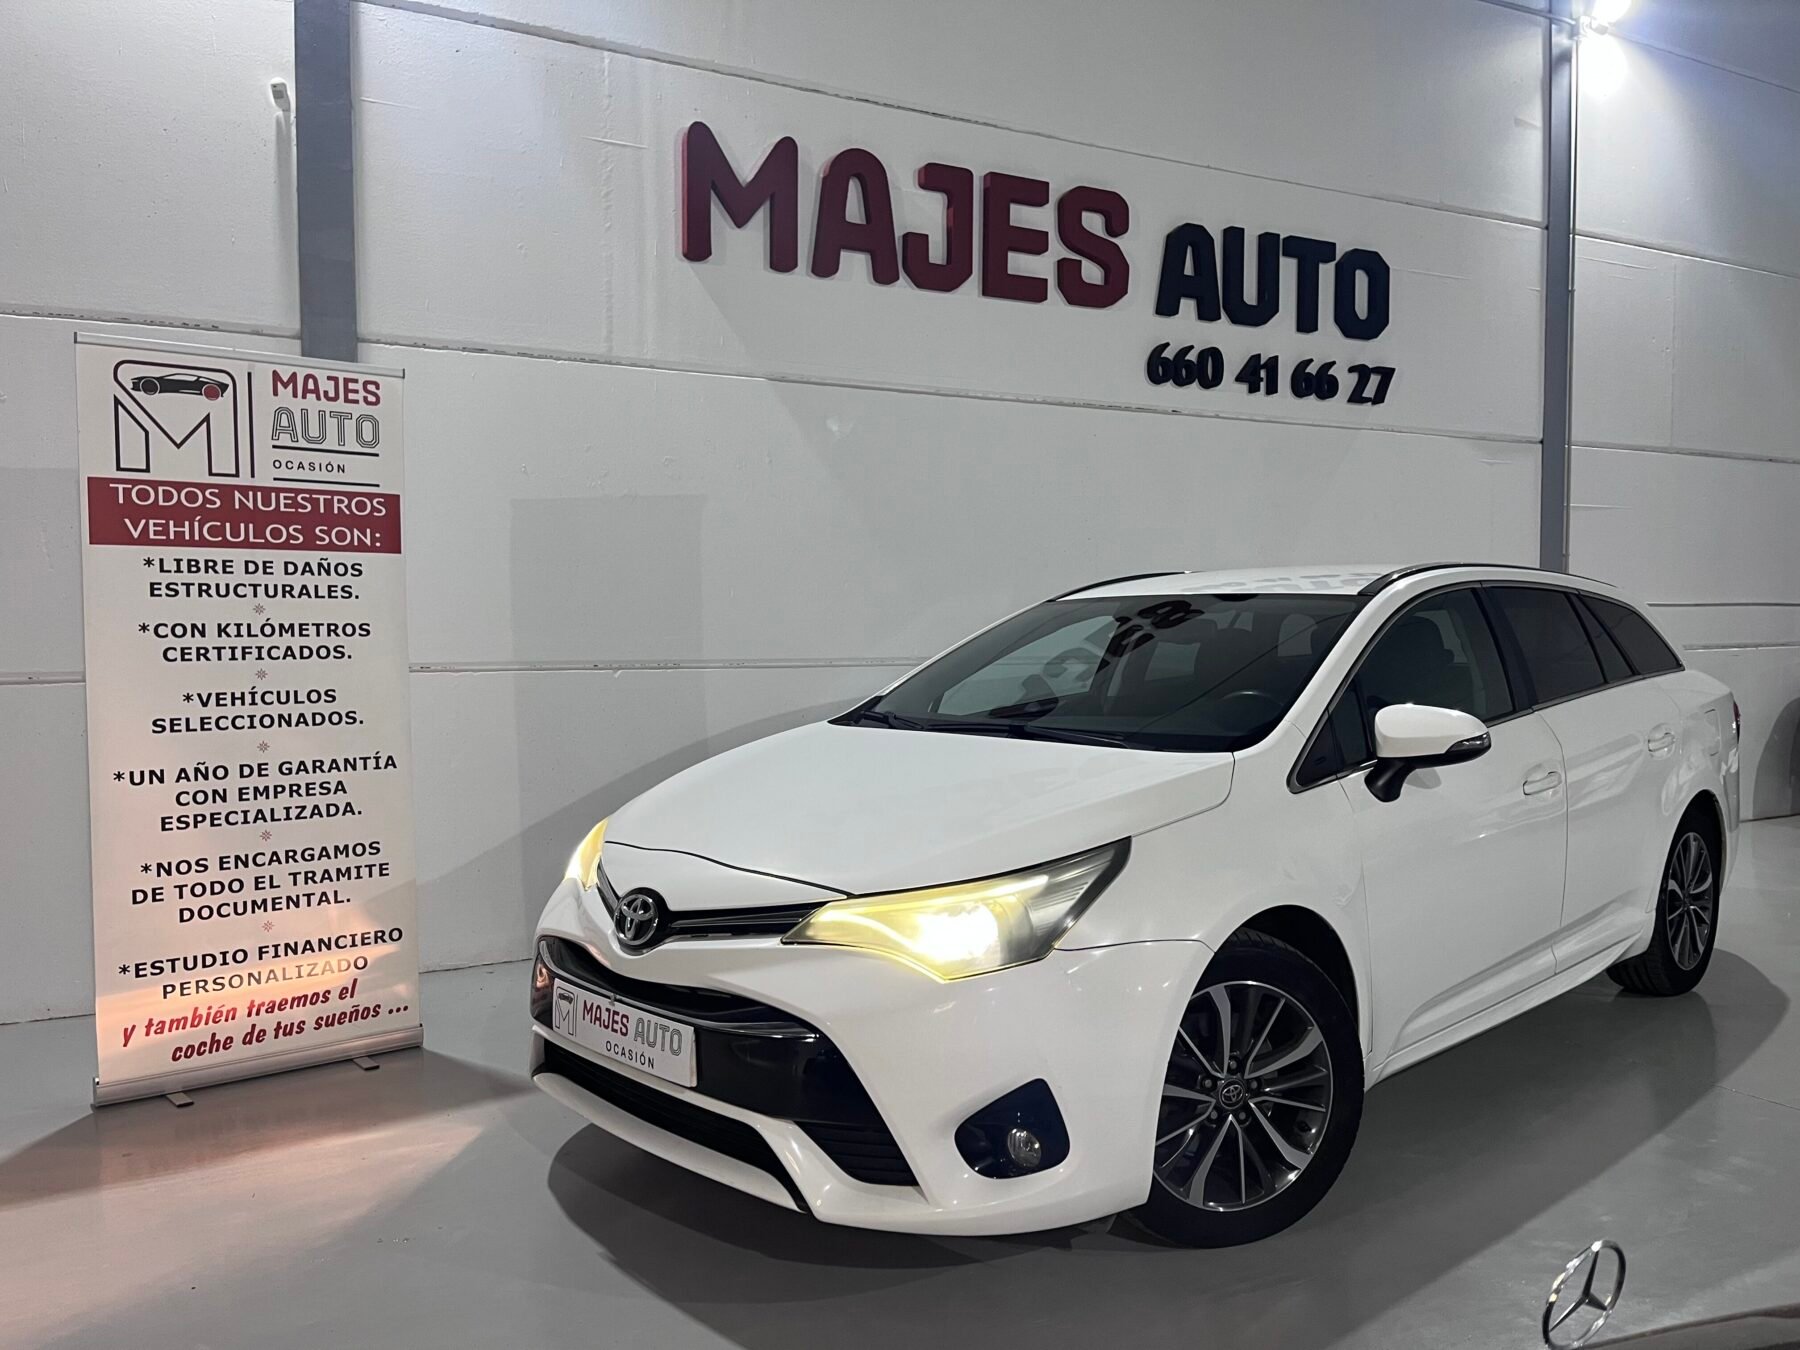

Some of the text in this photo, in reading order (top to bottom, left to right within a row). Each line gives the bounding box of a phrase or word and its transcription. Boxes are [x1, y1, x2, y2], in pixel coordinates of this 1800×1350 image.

[681, 120, 1391, 342] MAJES AUTO
[271, 370, 382, 407] MAJES
[1146, 341, 1396, 406] 660 41 66 27
[271, 406, 380, 449] AUTO
[272, 459, 347, 474] OCASIÓN
[110, 483, 387, 517] TODOS NUESTROS
[124, 516, 382, 547] VEHÍCULOS SON:
[243, 559, 275, 576] DE
[283, 557, 364, 577] DAÑOS
[149, 581, 360, 600] ESTRUCTURALES.
[216, 617, 372, 639] KILÓMETROS
[162, 645, 353, 662] CERTIFICADOS.
[150, 710, 365, 735] SELECCIONADOS.
[174, 761, 230, 783] AÑO
[238, 762, 270, 779] DE
[278, 751, 398, 777] GARANTÍA
[174, 780, 348, 807] CON EMPRESA
[160, 802, 363, 832] ESPECIALIZADA.
[218, 841, 382, 872] ENCARGAMOS
[131, 862, 391, 905] DE TODO EL TRAMITE
[178, 890, 352, 924] DOCUMENTAL.
[257, 927, 404, 961] FINANCIERO
[162, 956, 369, 1000] PERSONALIZADO
[122, 978, 358, 1048] y también traemos el
[582, 999, 682, 1056] MAJES AUTO
[171, 1032, 234, 1063] coche
[241, 1024, 267, 1047] de
[273, 1016, 306, 1040] tus
[313, 1002, 381, 1032] sueños
[605, 1040, 655, 1070] OCASIÓN
